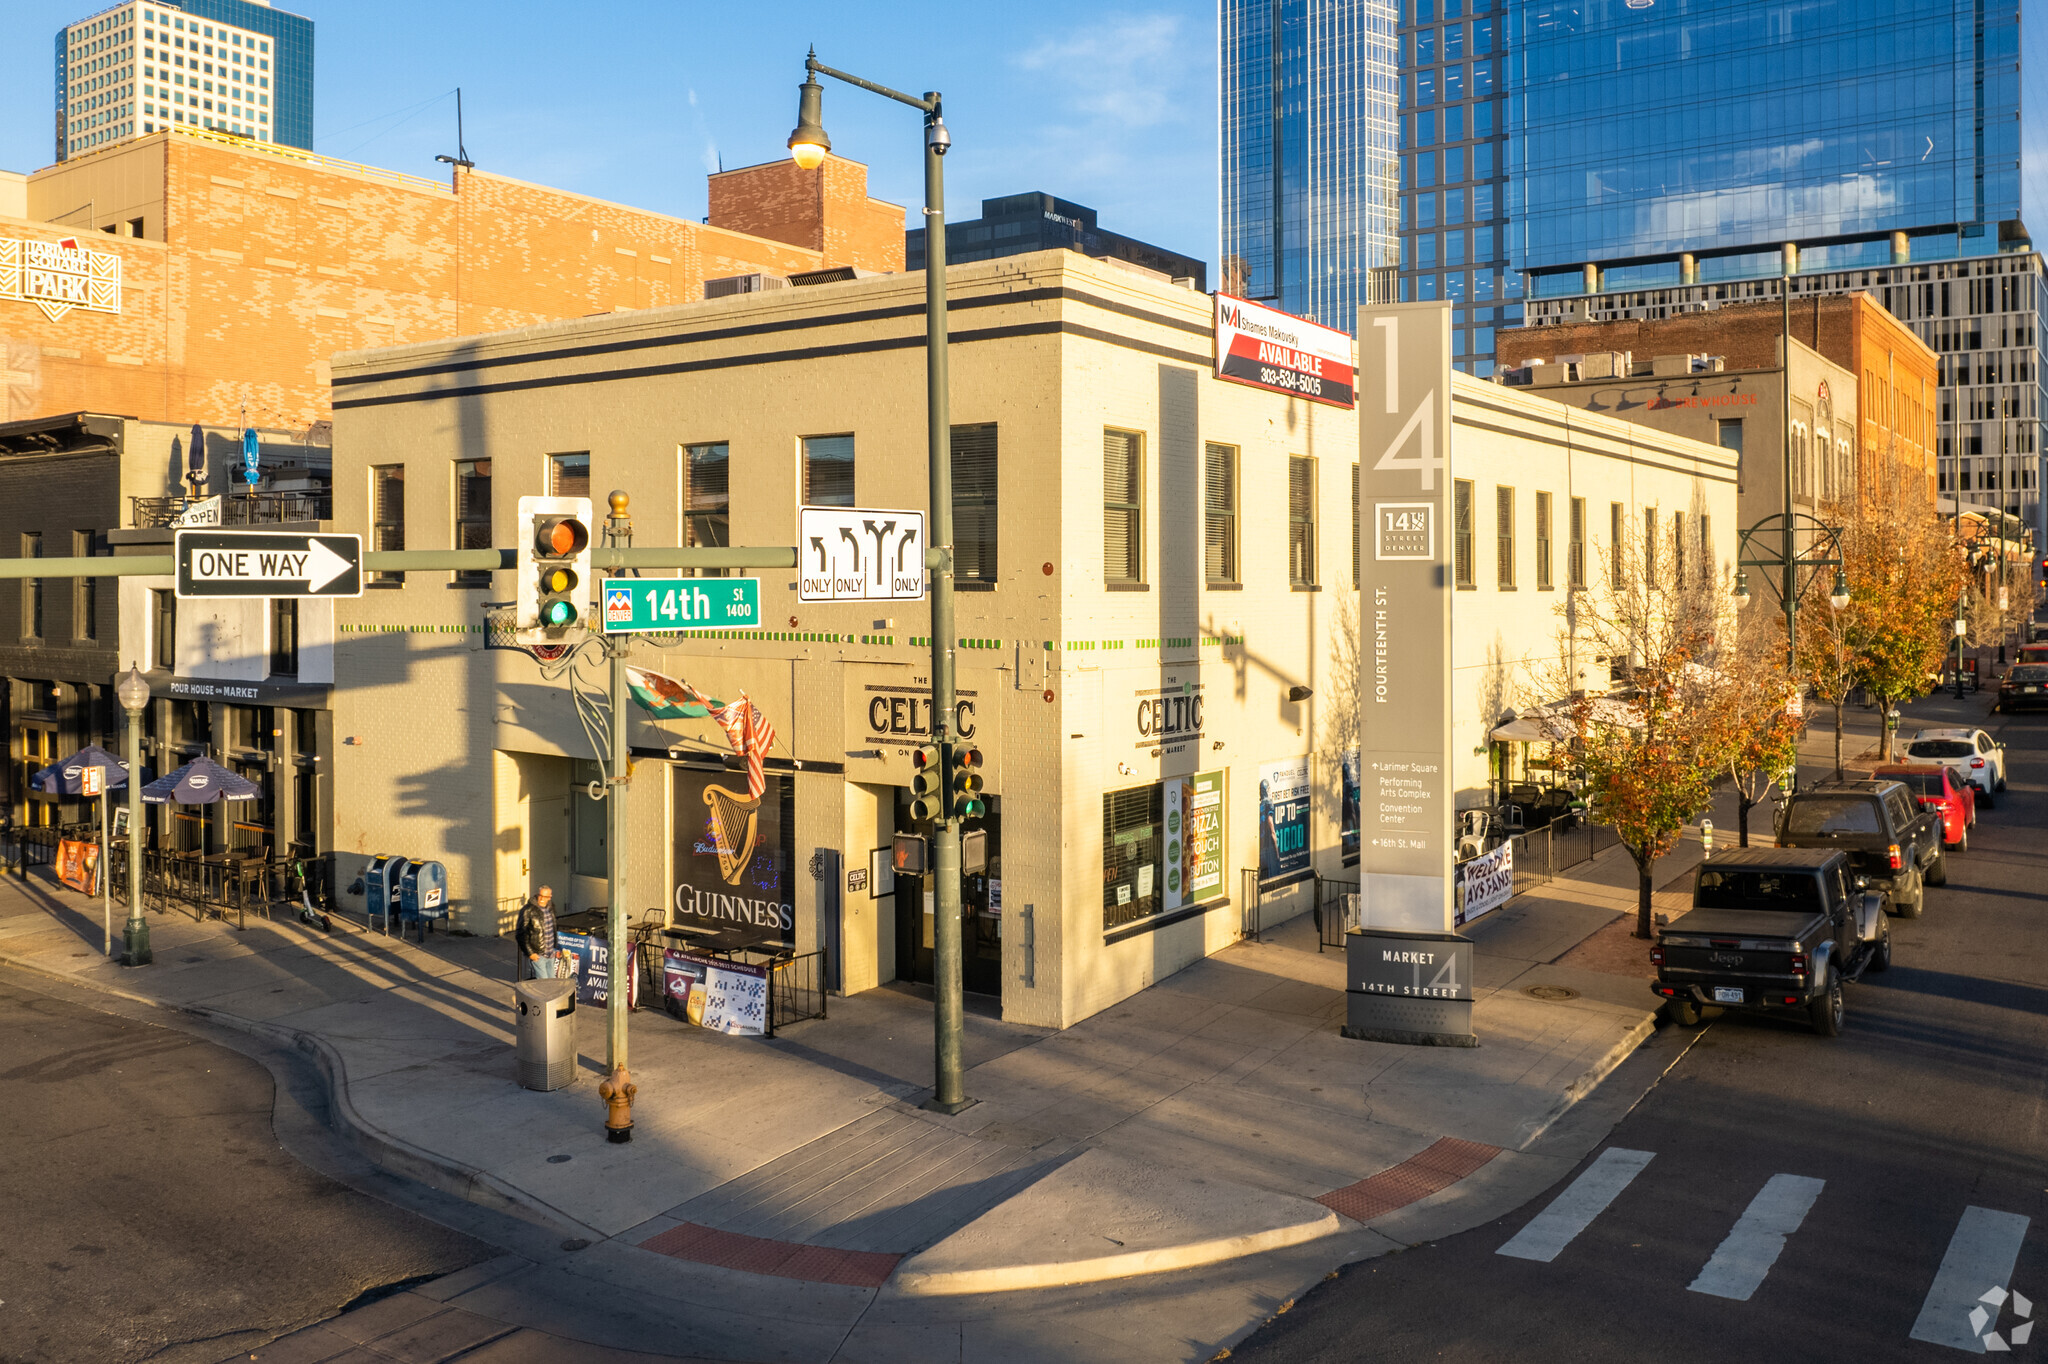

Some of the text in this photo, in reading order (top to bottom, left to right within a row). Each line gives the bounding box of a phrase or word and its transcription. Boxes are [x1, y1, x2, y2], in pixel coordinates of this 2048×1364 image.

[1044, 210, 1076, 227] MARKWEST
[29, 240, 88, 261] LARIMER
[29, 255, 89, 273] SQUARE
[29, 271, 87, 302] PARK
[1221, 304, 1240, 328] NAI
[1241, 317, 1299, 348] Shames Makovsky
[1258, 342, 1322, 376] AVAILABLE
[1260, 367, 1321, 395] 303-534-5005
[1675, 394, 1757, 409] BREWHOUSE
[191, 509, 218, 523] OPEN
[199, 553, 308, 577] ONE WAY
[803, 579, 831, 593] ONLY
[836, 578, 863, 592] ONLY
[894, 578, 920, 591] ONLY
[733, 588, 744, 601] St
[645, 587, 710, 621] 14th
[726, 603, 751, 617] 1400
[607, 610, 632, 621] DENVER
[1375, 585, 1387, 703] FOURTEENTH ST.
[170, 683, 189, 694] POUR
[190, 684, 214, 695] HOUSE
[223, 686, 258, 699] MARKET
[869, 696, 975, 739] CELTC
[1138, 695, 1204, 737] CELTIC
[1166, 745, 1186, 754] MARKET
[1380, 762, 1438, 773] Larimer Square
[1380, 777, 1423, 789] Performing
[1272, 784, 1310, 801] FIRST BET RISK FREE
[1380, 789, 1431, 799] Arts Complex
[1275, 804, 1286, 825] UP
[1286, 802, 1296, 821] TO
[1380, 803, 1423, 814] Convention
[1190, 812, 1219, 834] PIZZA
[1380, 814, 1405, 824] Center
[1275, 823, 1304, 853] $1000
[1380, 838, 1426, 849] 16th St. Mall
[1190, 837, 1219, 856] TOUCH
[1190, 859, 1219, 878] BUTTON
[1466, 847, 1512, 882] WELCOME
[850, 871, 866, 882] CELTIC
[1467, 867, 1512, 906] AVS FANS!
[675, 884, 792, 931] GUINNESS
[1383, 950, 1434, 965] MARKET
[1710, 952, 1743, 966] Jeep
[592, 964, 607, 972] HARD
[731, 964, 757, 974] SCHEDULE
[1362, 982, 1458, 998] 14TH STREET
